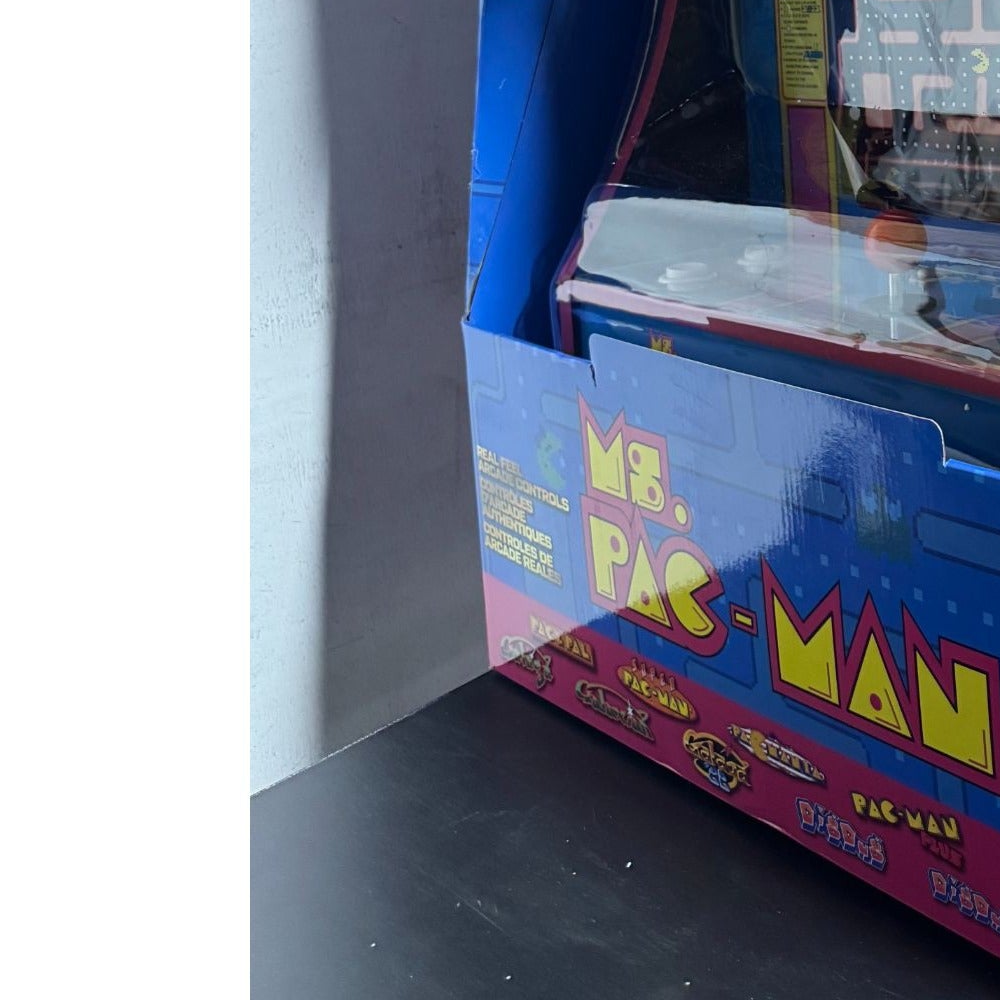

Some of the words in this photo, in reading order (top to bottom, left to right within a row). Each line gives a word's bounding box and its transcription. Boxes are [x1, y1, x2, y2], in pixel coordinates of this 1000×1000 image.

[477, 444, 499, 466] REAL
[500, 456, 521, 476] FEEL
[478, 460, 515, 487] ARCADE
[516, 477, 570, 512] CONTROLS
[483, 505, 553, 550] AUTHENTIQUES
[484, 521, 538, 559] CONTROLES
[538, 551, 554, 568] DE
[485, 535, 521, 565] ARCADE
[522, 556, 563, 586] REALES
[623, 670, 690, 719] PAC-MAN
[850, 791, 962, 843] PAC-MAN
